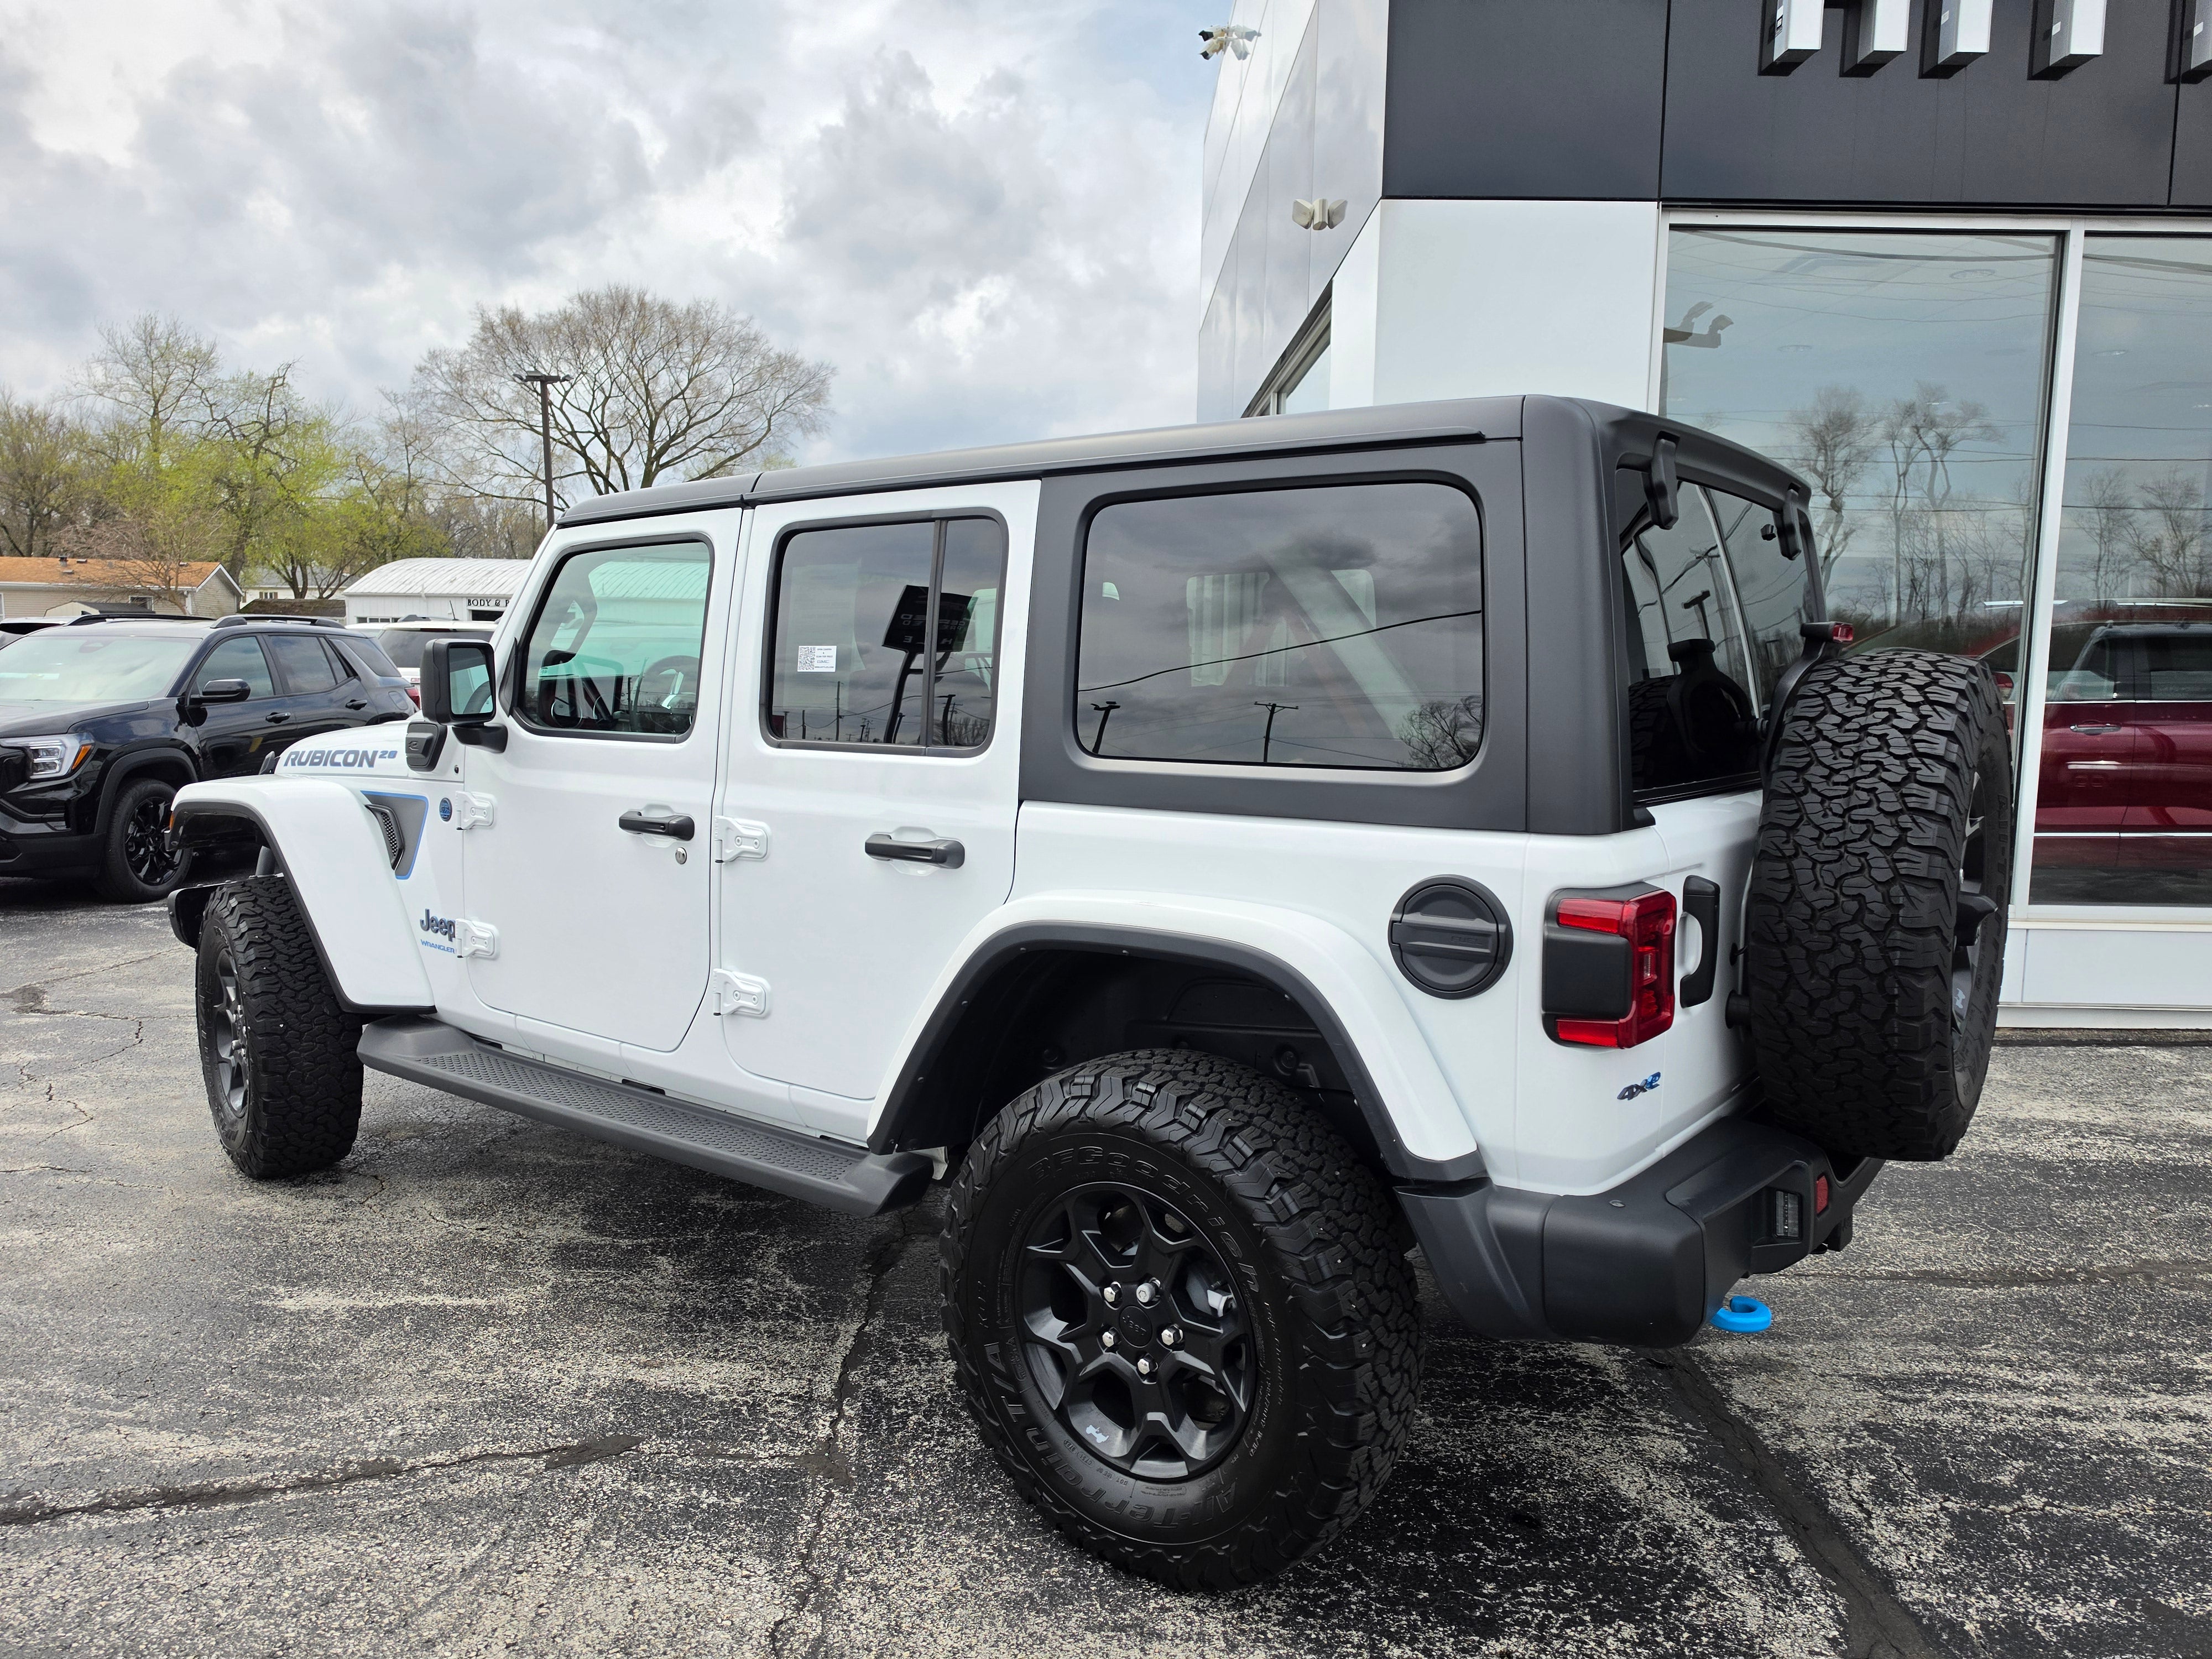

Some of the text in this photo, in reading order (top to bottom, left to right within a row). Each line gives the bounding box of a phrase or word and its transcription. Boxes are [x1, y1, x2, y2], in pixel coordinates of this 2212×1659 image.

[284, 749, 378, 768] RUBICON
[420, 908, 456, 942] Jeep
[420, 939, 455, 954] WRANGLER
[1451, 936, 1483, 946] FUEL
[1027, 1145, 1260, 1294] BFGoodrich
